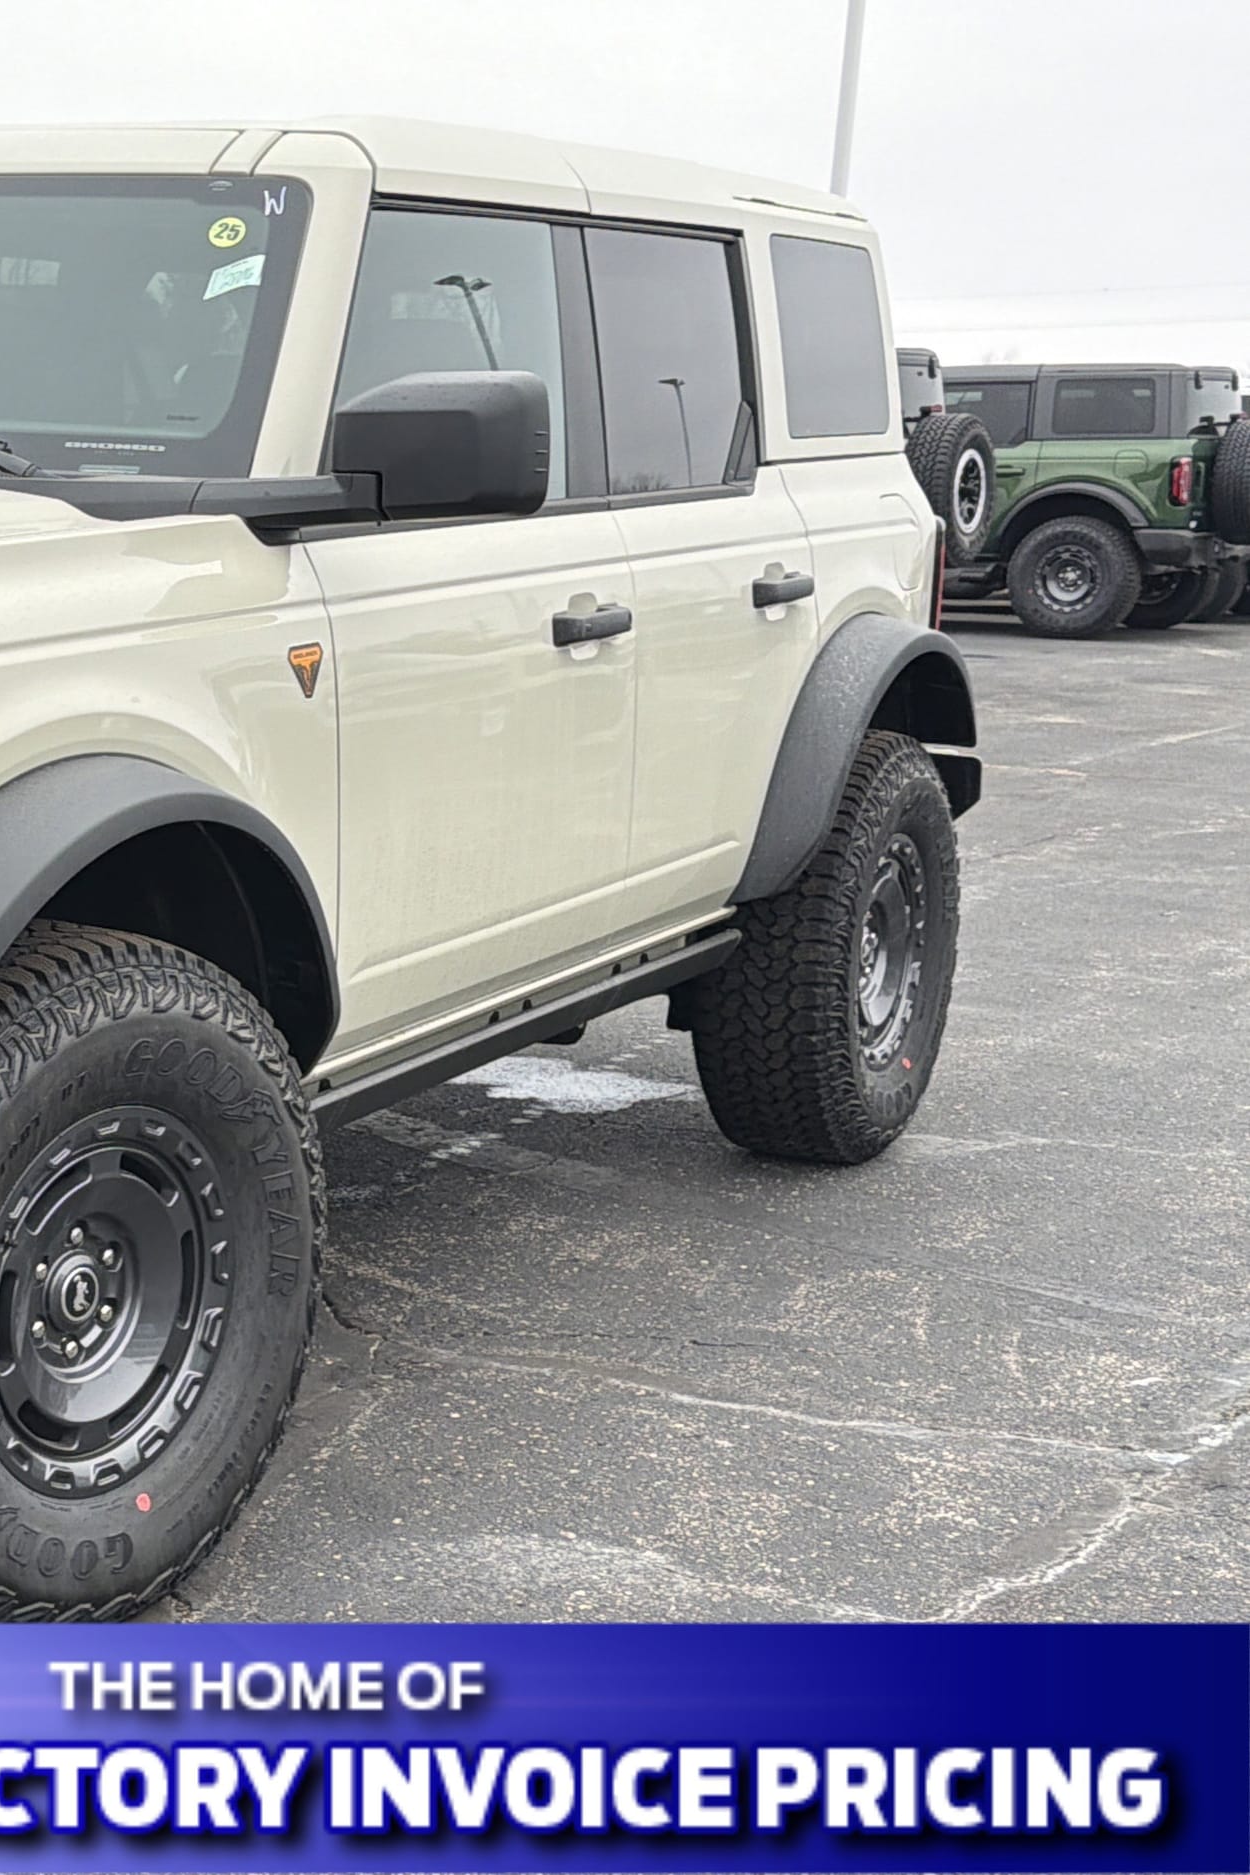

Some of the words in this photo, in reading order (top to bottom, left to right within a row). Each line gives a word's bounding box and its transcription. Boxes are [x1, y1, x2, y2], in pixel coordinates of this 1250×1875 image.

[263, 186, 287, 216] W
[213, 222, 243, 241] 25
[124, 1038, 303, 1299] GOODYEAR
